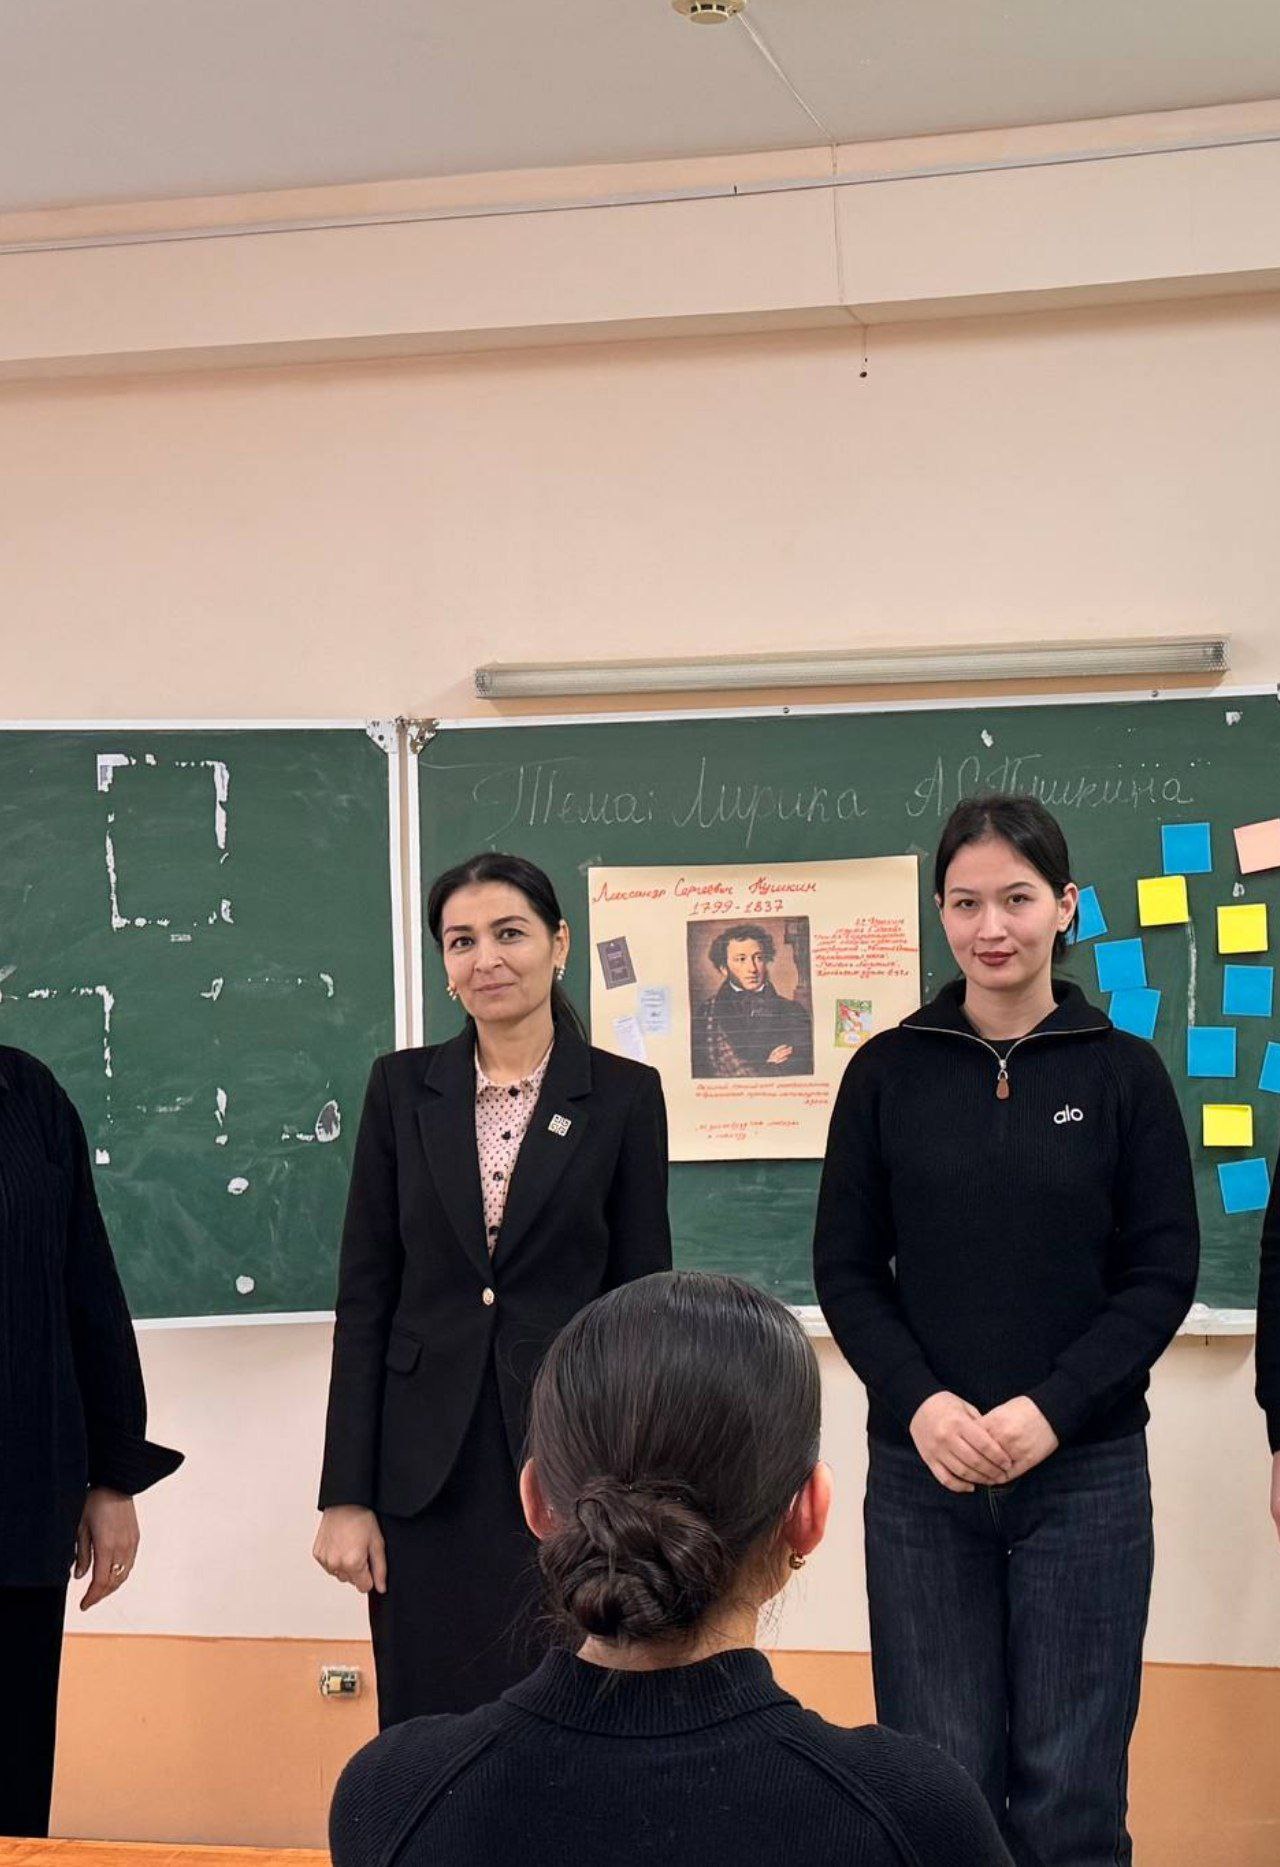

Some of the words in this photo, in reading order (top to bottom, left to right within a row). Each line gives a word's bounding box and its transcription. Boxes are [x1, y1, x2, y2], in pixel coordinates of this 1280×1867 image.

[674, 756, 868, 848] Лирика
[592, 882, 666, 904] Александр
[674, 877, 733, 897] Сергеевич
[749, 876, 817, 895] Пушкин
[1054, 1103, 1083, 1124] alo
